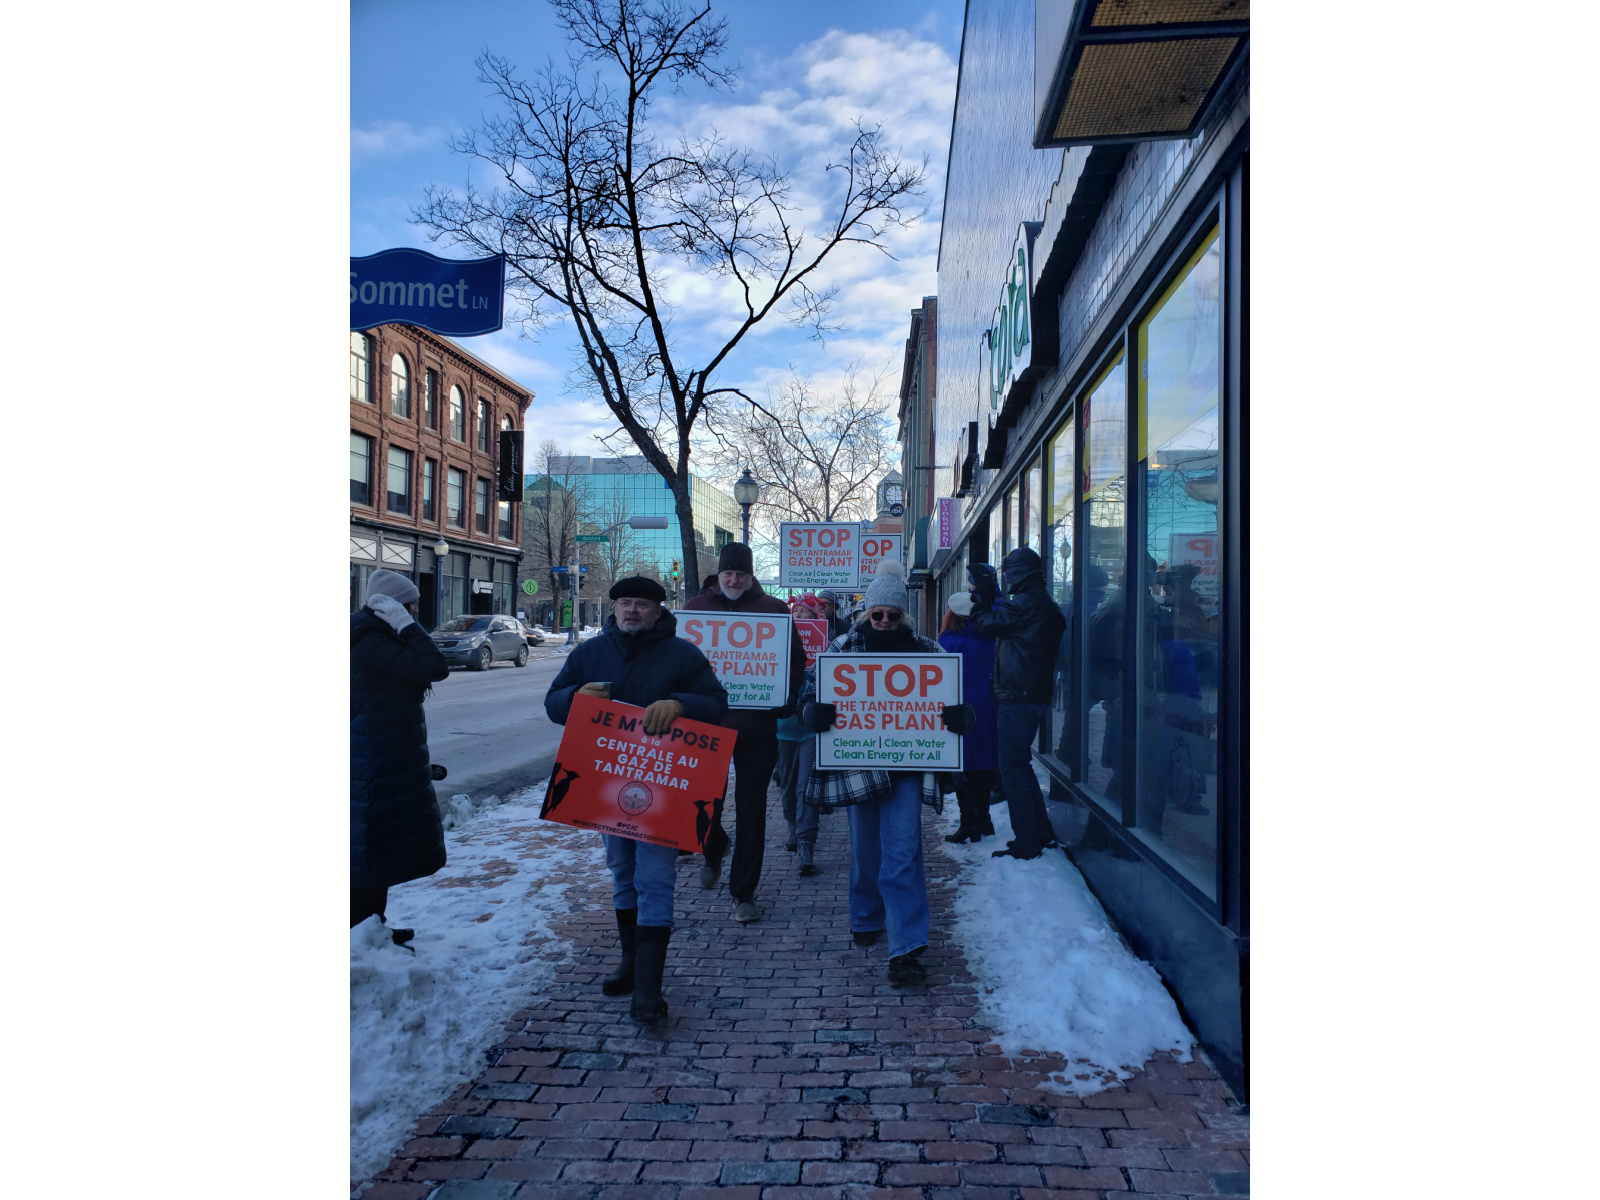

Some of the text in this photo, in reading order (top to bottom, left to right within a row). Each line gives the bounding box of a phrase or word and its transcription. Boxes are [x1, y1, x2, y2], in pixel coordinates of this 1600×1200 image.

[472, 296, 488, 310] LN
[789, 528, 851, 548] STOP
[862, 539, 893, 557] OP
[788, 557, 813, 567] GAS
[816, 557, 853, 567] PLANT
[684, 619, 776, 648] STOP
[705, 650, 776, 661] TANTRAMAR
[722, 661, 778, 676] PLANT
[724, 681, 775, 691] Clean Water
[833, 664, 943, 697] STOP
[744, 692, 757, 701] for
[758, 693, 770, 701] All
[832, 701, 945, 712] THE TANTRAMAR
[591, 710, 614, 727] JE
[834, 713, 944, 730] GAS PLANT
[642, 736, 660, 746] à la
[833, 738, 945, 748] Clean Air Clean Water
[597, 736, 698, 768] CENTRALE AU
[834, 750, 940, 762] Clean Energy for All
[618, 754, 673, 774] GAZ DE
[594, 760, 689, 790] TANTRAMAR
[617, 822, 638, 831] #PCIC
